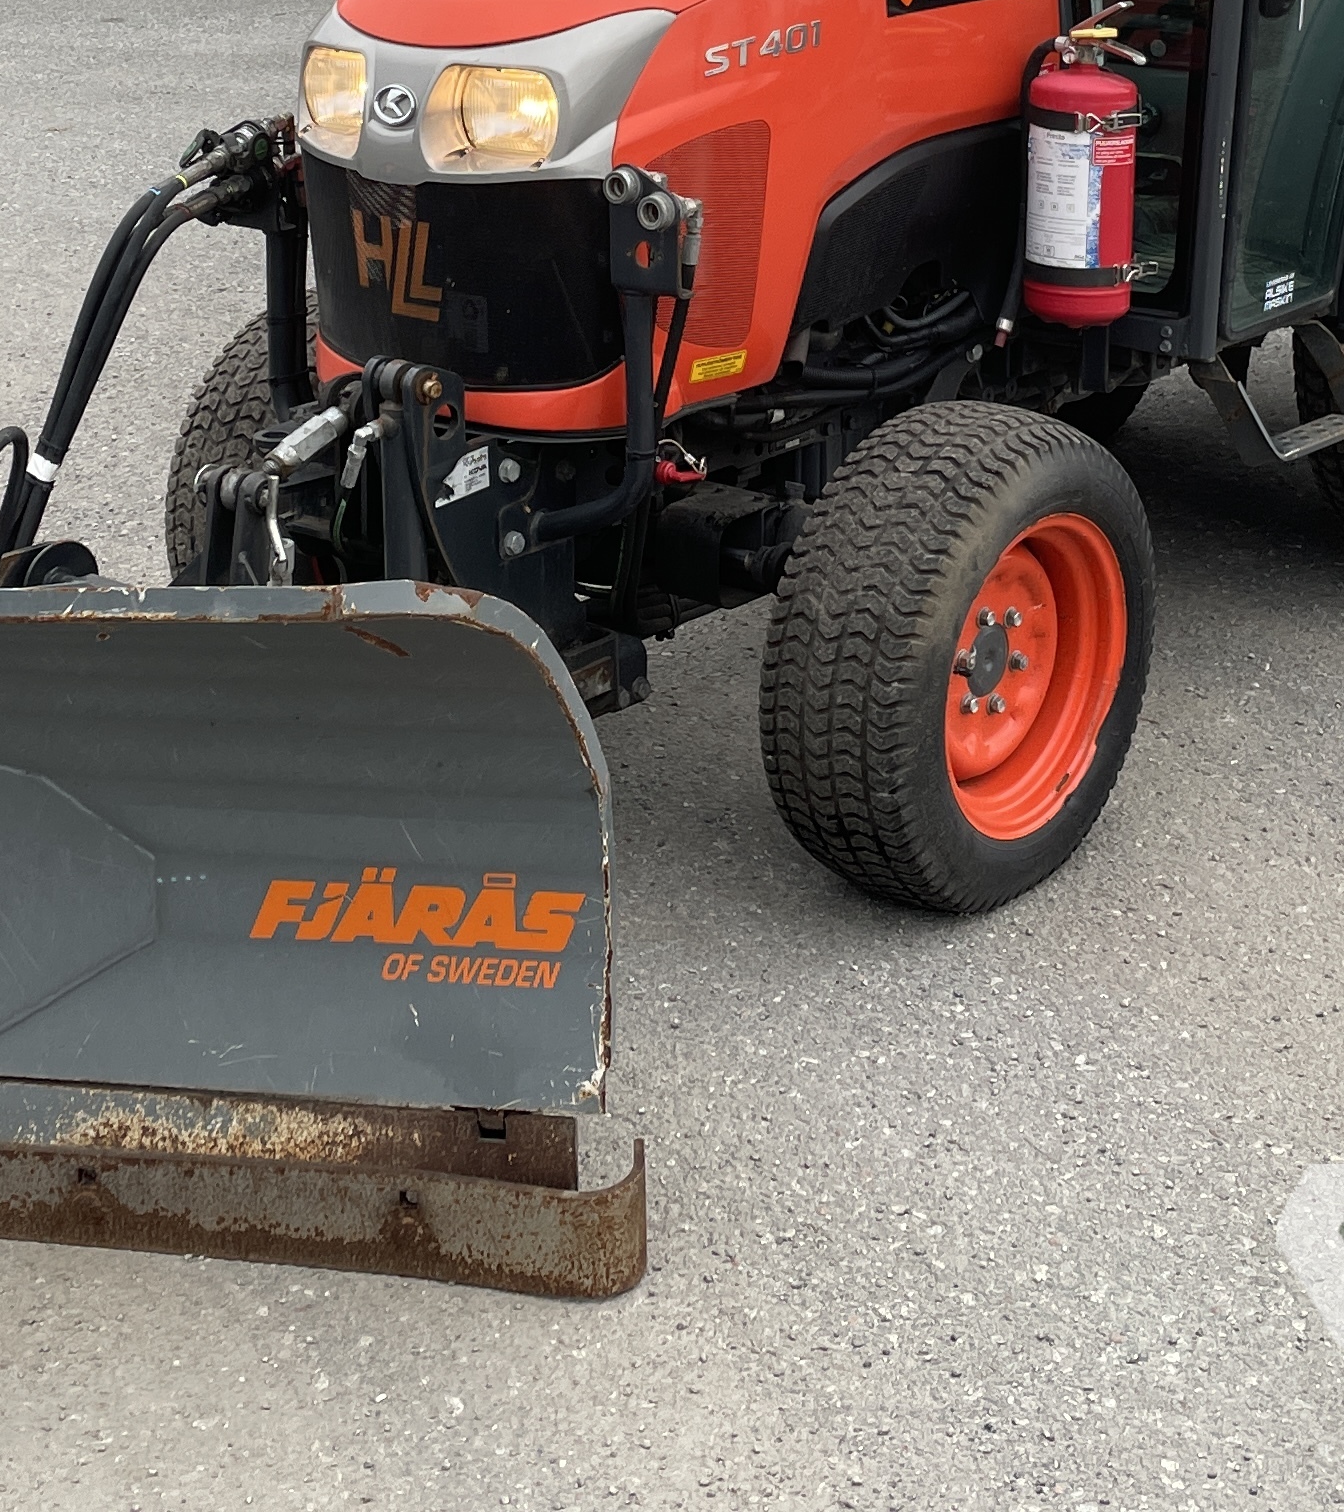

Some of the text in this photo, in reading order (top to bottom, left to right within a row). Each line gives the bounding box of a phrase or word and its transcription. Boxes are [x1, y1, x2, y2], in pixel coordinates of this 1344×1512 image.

[352, 209, 443, 322] HLL
[250, 867, 586, 953] FJÄRÅS
[381, 953, 562, 989] OF SWEDEN
